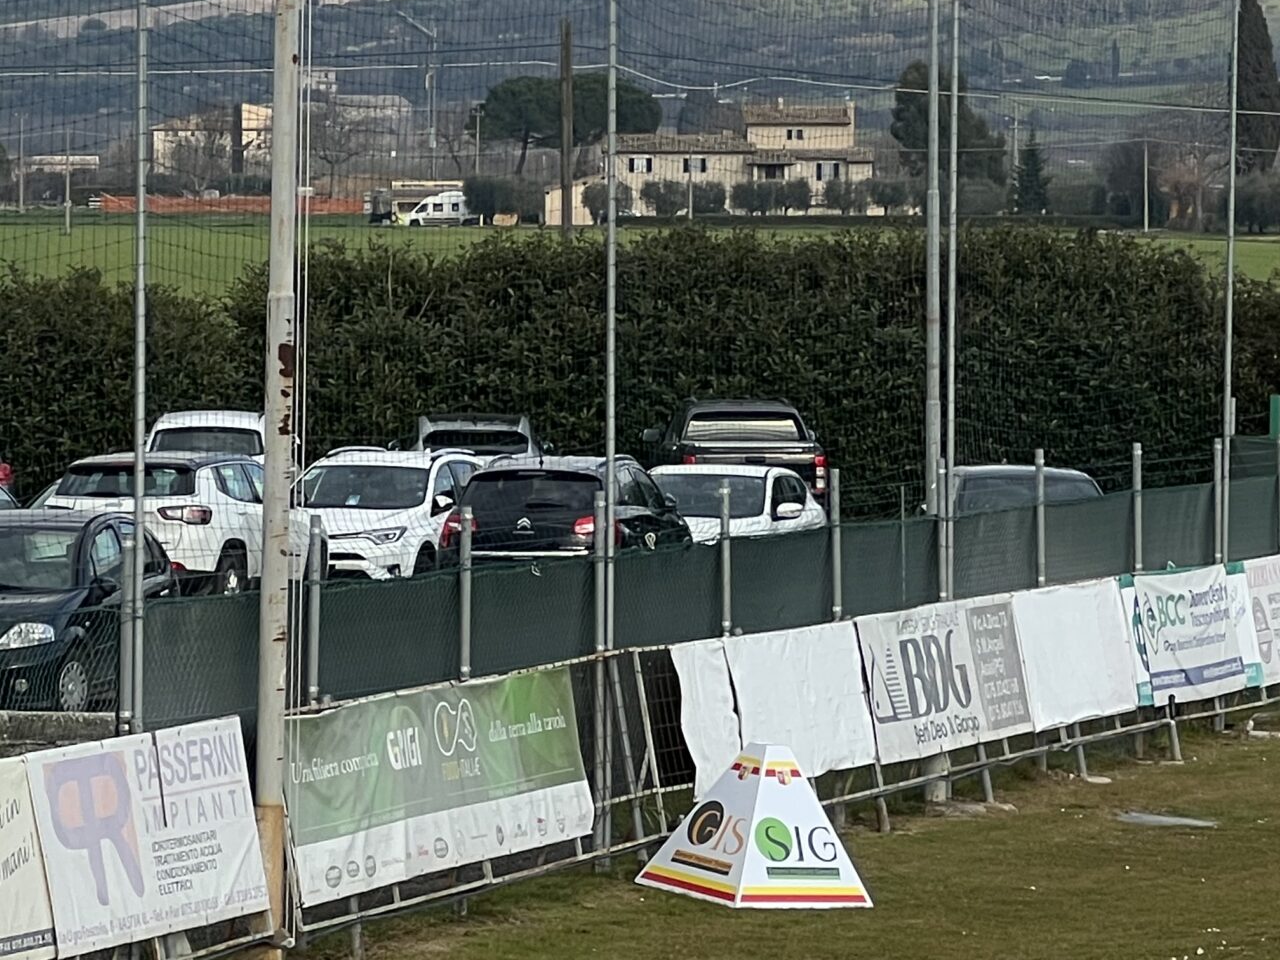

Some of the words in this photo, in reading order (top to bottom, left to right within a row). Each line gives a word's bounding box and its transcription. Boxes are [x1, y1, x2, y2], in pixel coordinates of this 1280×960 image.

[1156, 592, 1186, 628] BCC
[898, 629, 972, 718] BDG
[133, 732, 243, 792] PASSERINI
[142, 786, 249, 834] IMPIANTI
[690, 810, 747, 855] GIS
[764, 825, 838, 863] SIG
